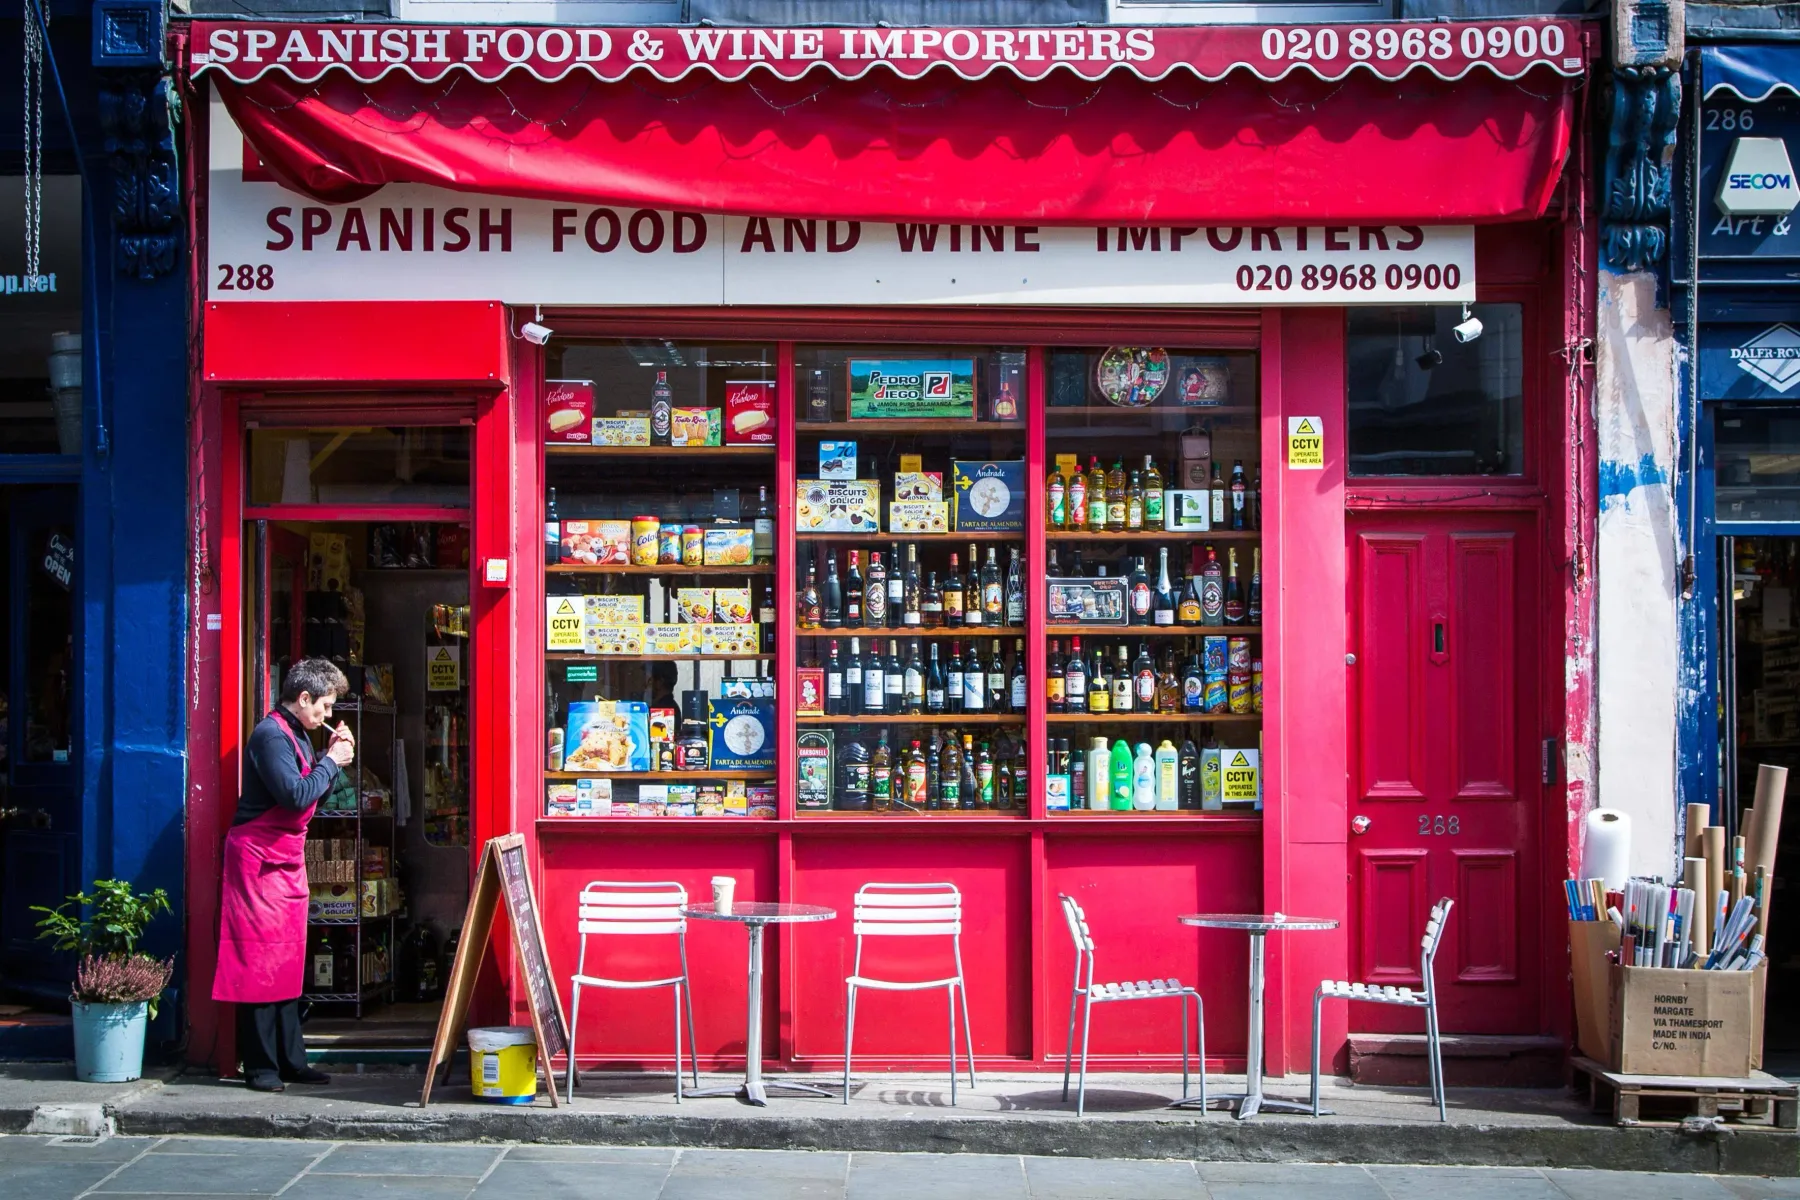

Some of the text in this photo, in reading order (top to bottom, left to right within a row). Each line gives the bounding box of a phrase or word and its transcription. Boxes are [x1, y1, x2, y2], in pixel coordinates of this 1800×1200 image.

[208, 28, 1157, 64] SPANISH FOOD & WINE IMPORTERS
[1261, 25, 1566, 60] 020 8968 0900
[1705, 109, 1754, 131] 286
[1729, 173, 1791, 190] SECOM
[265, 206, 1426, 254] SPANISH FOOD AND WINE IMPORTERS
[1711, 215, 1792, 236] Art &
[216, 263, 275, 291] 288
[1235, 263, 1461, 291] 020 8968 0900
[869, 371, 920, 385] PEDRO
[1292, 438, 1320, 449] CCTV
[975, 469, 1007, 477] Andrade
[829, 497, 864, 505] GALICIA
[44, 555, 71, 585] OPEN
[552, 619, 580, 630] CCTV
[431, 664, 456, 674] CCTV
[730, 706, 760, 715] Andrade
[1226, 771, 1255, 782] CCTV
[1417, 814, 1460, 836] 288
[1654, 994, 1689, 1005] HORNBY
[1653, 1006, 1694, 1017] MARGATE
[1653, 1017, 1724, 1029] VIA THAMESPORT
[1652, 1029, 1712, 1040] MADE IN INDIA
[1652, 1041, 1678, 1051] C/NO.
